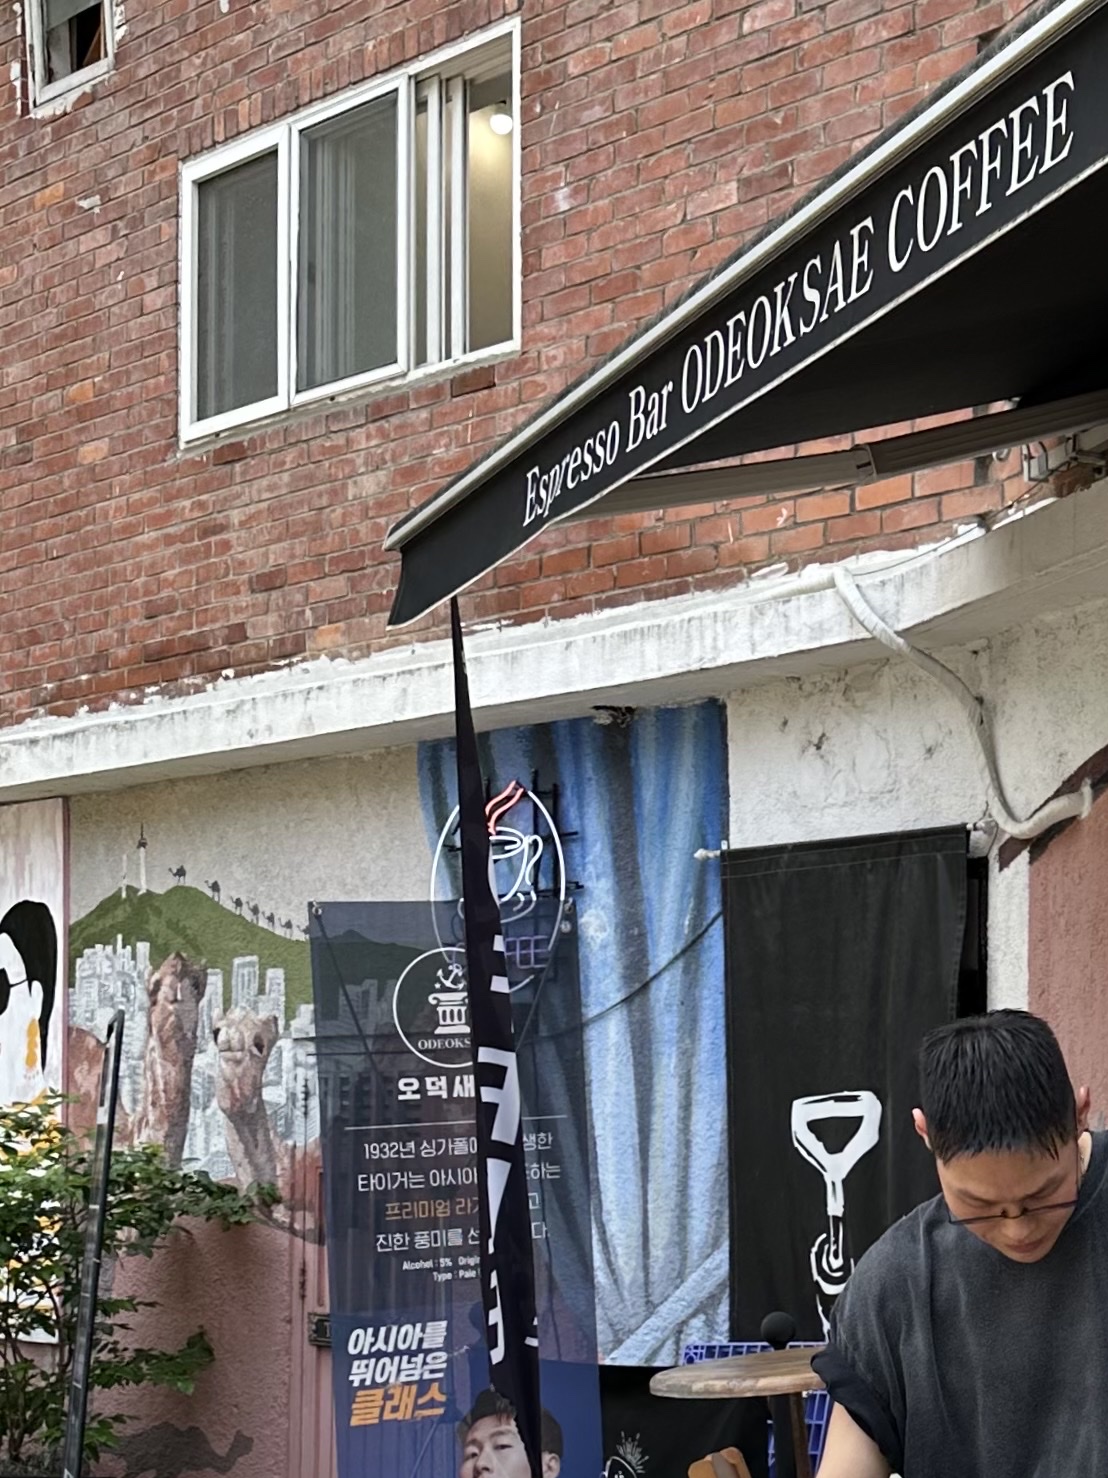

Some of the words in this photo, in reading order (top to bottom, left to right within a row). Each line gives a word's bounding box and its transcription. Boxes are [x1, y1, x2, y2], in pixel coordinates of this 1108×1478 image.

[523, 421, 619, 526] Espresso
[625, 378, 673, 454] Bar
[681, 216, 876, 414] ODEOKSAE
[888, 71, 1076, 273] COFFEE
[418, 1038, 471, 1050] ODEOKS
[363, 1140, 416, 1160] 1932년
[523, 1132, 553, 1151] 생한
[357, 1170, 425, 1192] 타이거는
[429, 1166, 478, 1187] 아시아
[385, 1197, 450, 1221] 프리미엄
[376, 1232, 410, 1253] 진한
[414, 1227, 463, 1250] 풍미를
[402, 1259, 433, 1270] Alcohol
[347, 1320, 448, 1355] 아시아를
[348, 1351, 448, 1387] 뛰어넘은
[350, 1382, 447, 1426] 클래스
